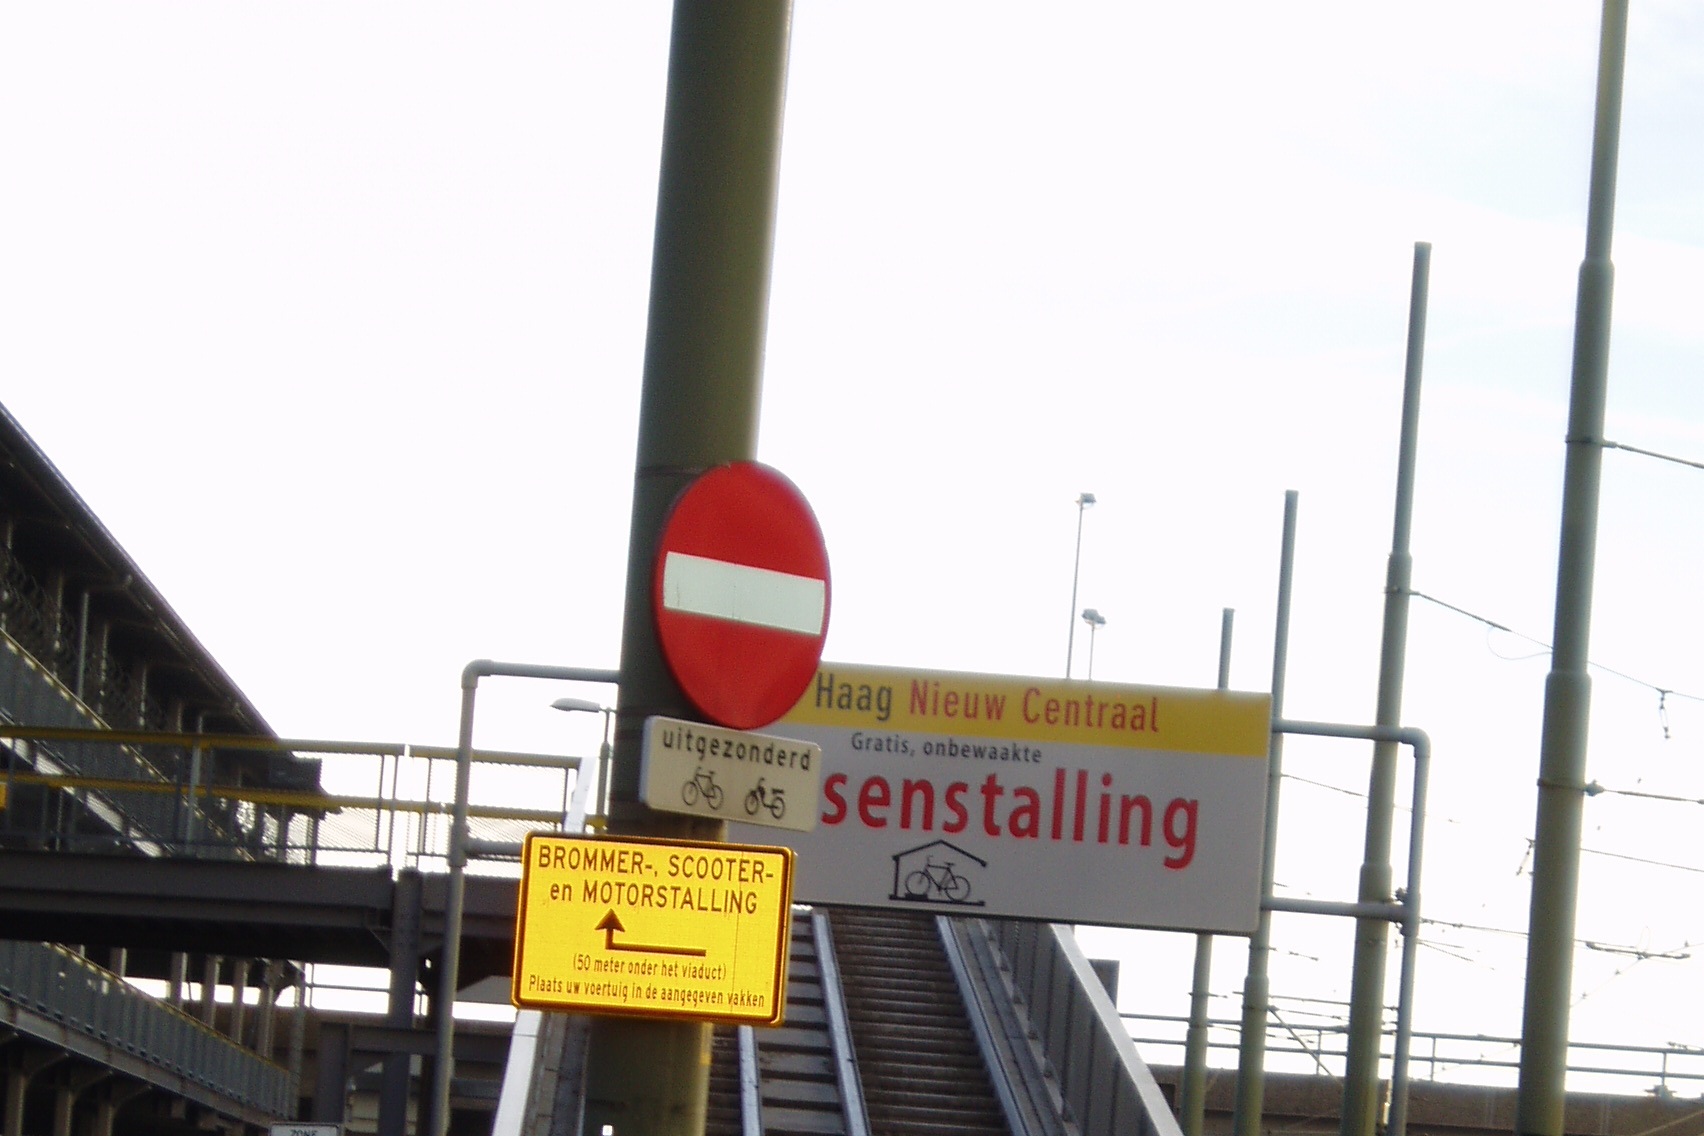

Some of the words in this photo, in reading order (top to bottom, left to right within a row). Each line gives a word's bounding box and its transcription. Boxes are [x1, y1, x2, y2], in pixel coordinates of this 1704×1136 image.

[815, 672, 893, 722] Haag
[909, 679, 1006, 721] Nieuw
[1022, 686, 1160, 733] Centraal
[662, 726, 812, 772] uitgezonderd
[851, 731, 916, 757] Gratis,
[922, 738, 1042, 763] onbewaakte
[820, 767, 1200, 870] senstalling
[538, 844, 659, 878] BROMMER-,
[667, 853, 774, 884] SCOOTER-
[549, 882, 573, 902] en
[582, 879, 758, 915] MOTORSTALLING
[572, 952, 592, 972] (50
[593, 956, 625, 974] meter
[627, 958, 658, 976] onder
[660, 959, 679, 978] het
[681, 961, 727, 981] viaduct)
[528, 973, 563, 993] Plaats
[565, 980, 581, 995] uw
[584, 980, 629, 1003] voertuig
[631, 982, 643, 999] in
[644, 982, 658, 1000] de
[660, 986, 724, 1008] aangegeven
[727, 988, 766, 1008] vakken
